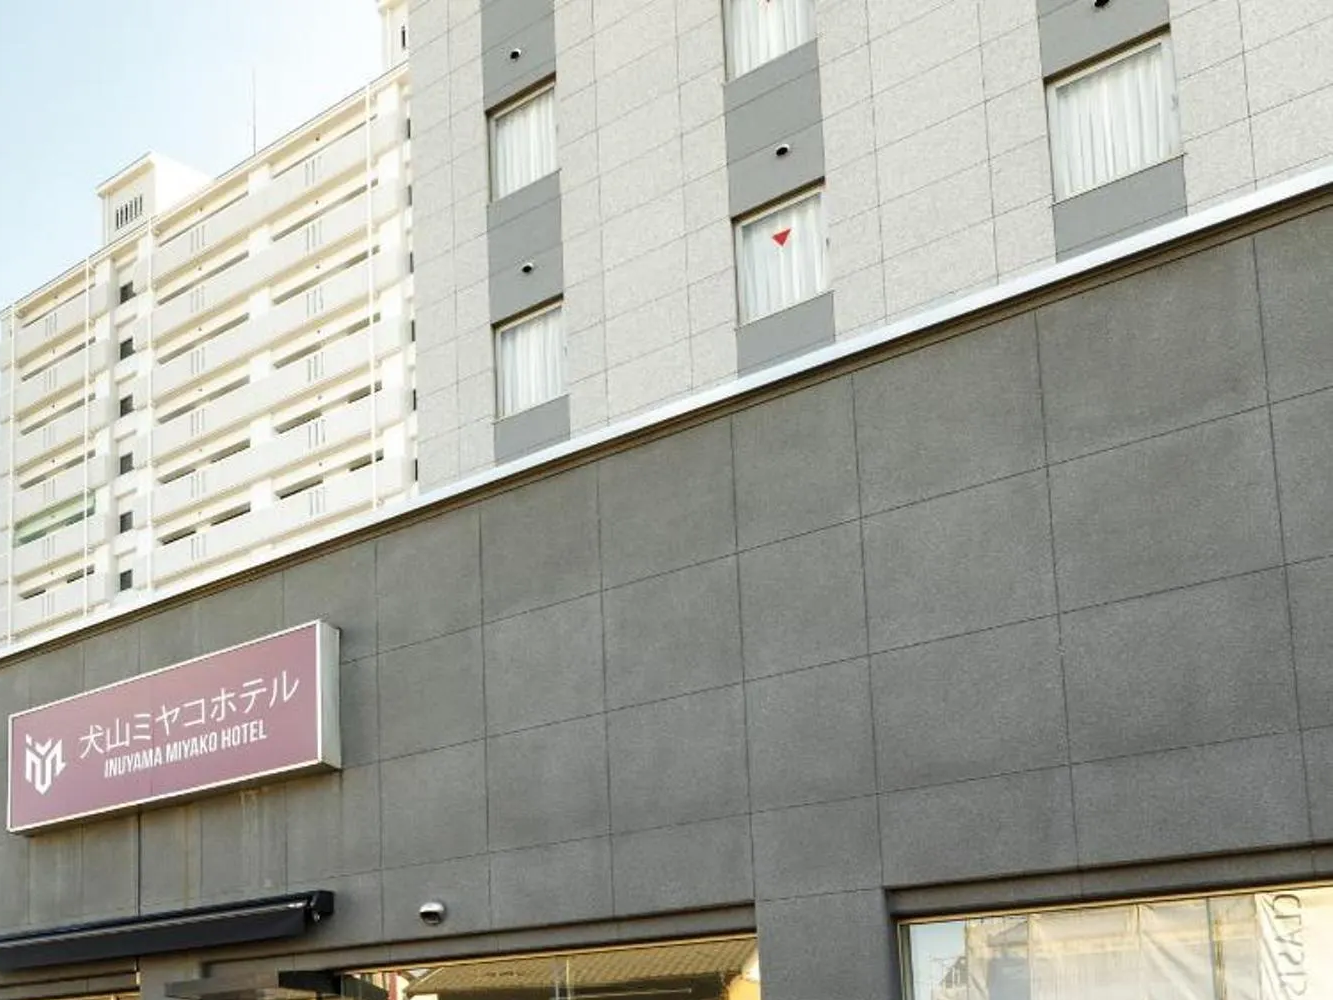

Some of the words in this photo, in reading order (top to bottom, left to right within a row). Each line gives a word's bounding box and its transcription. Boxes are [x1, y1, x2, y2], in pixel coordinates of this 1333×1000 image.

[78, 670, 299, 759] 犬山ミヤコホテル
[103, 747, 163, 778] INUYAMA
[166, 732, 217, 763] MIYAKO
[221, 719, 267, 750] HOTEL
